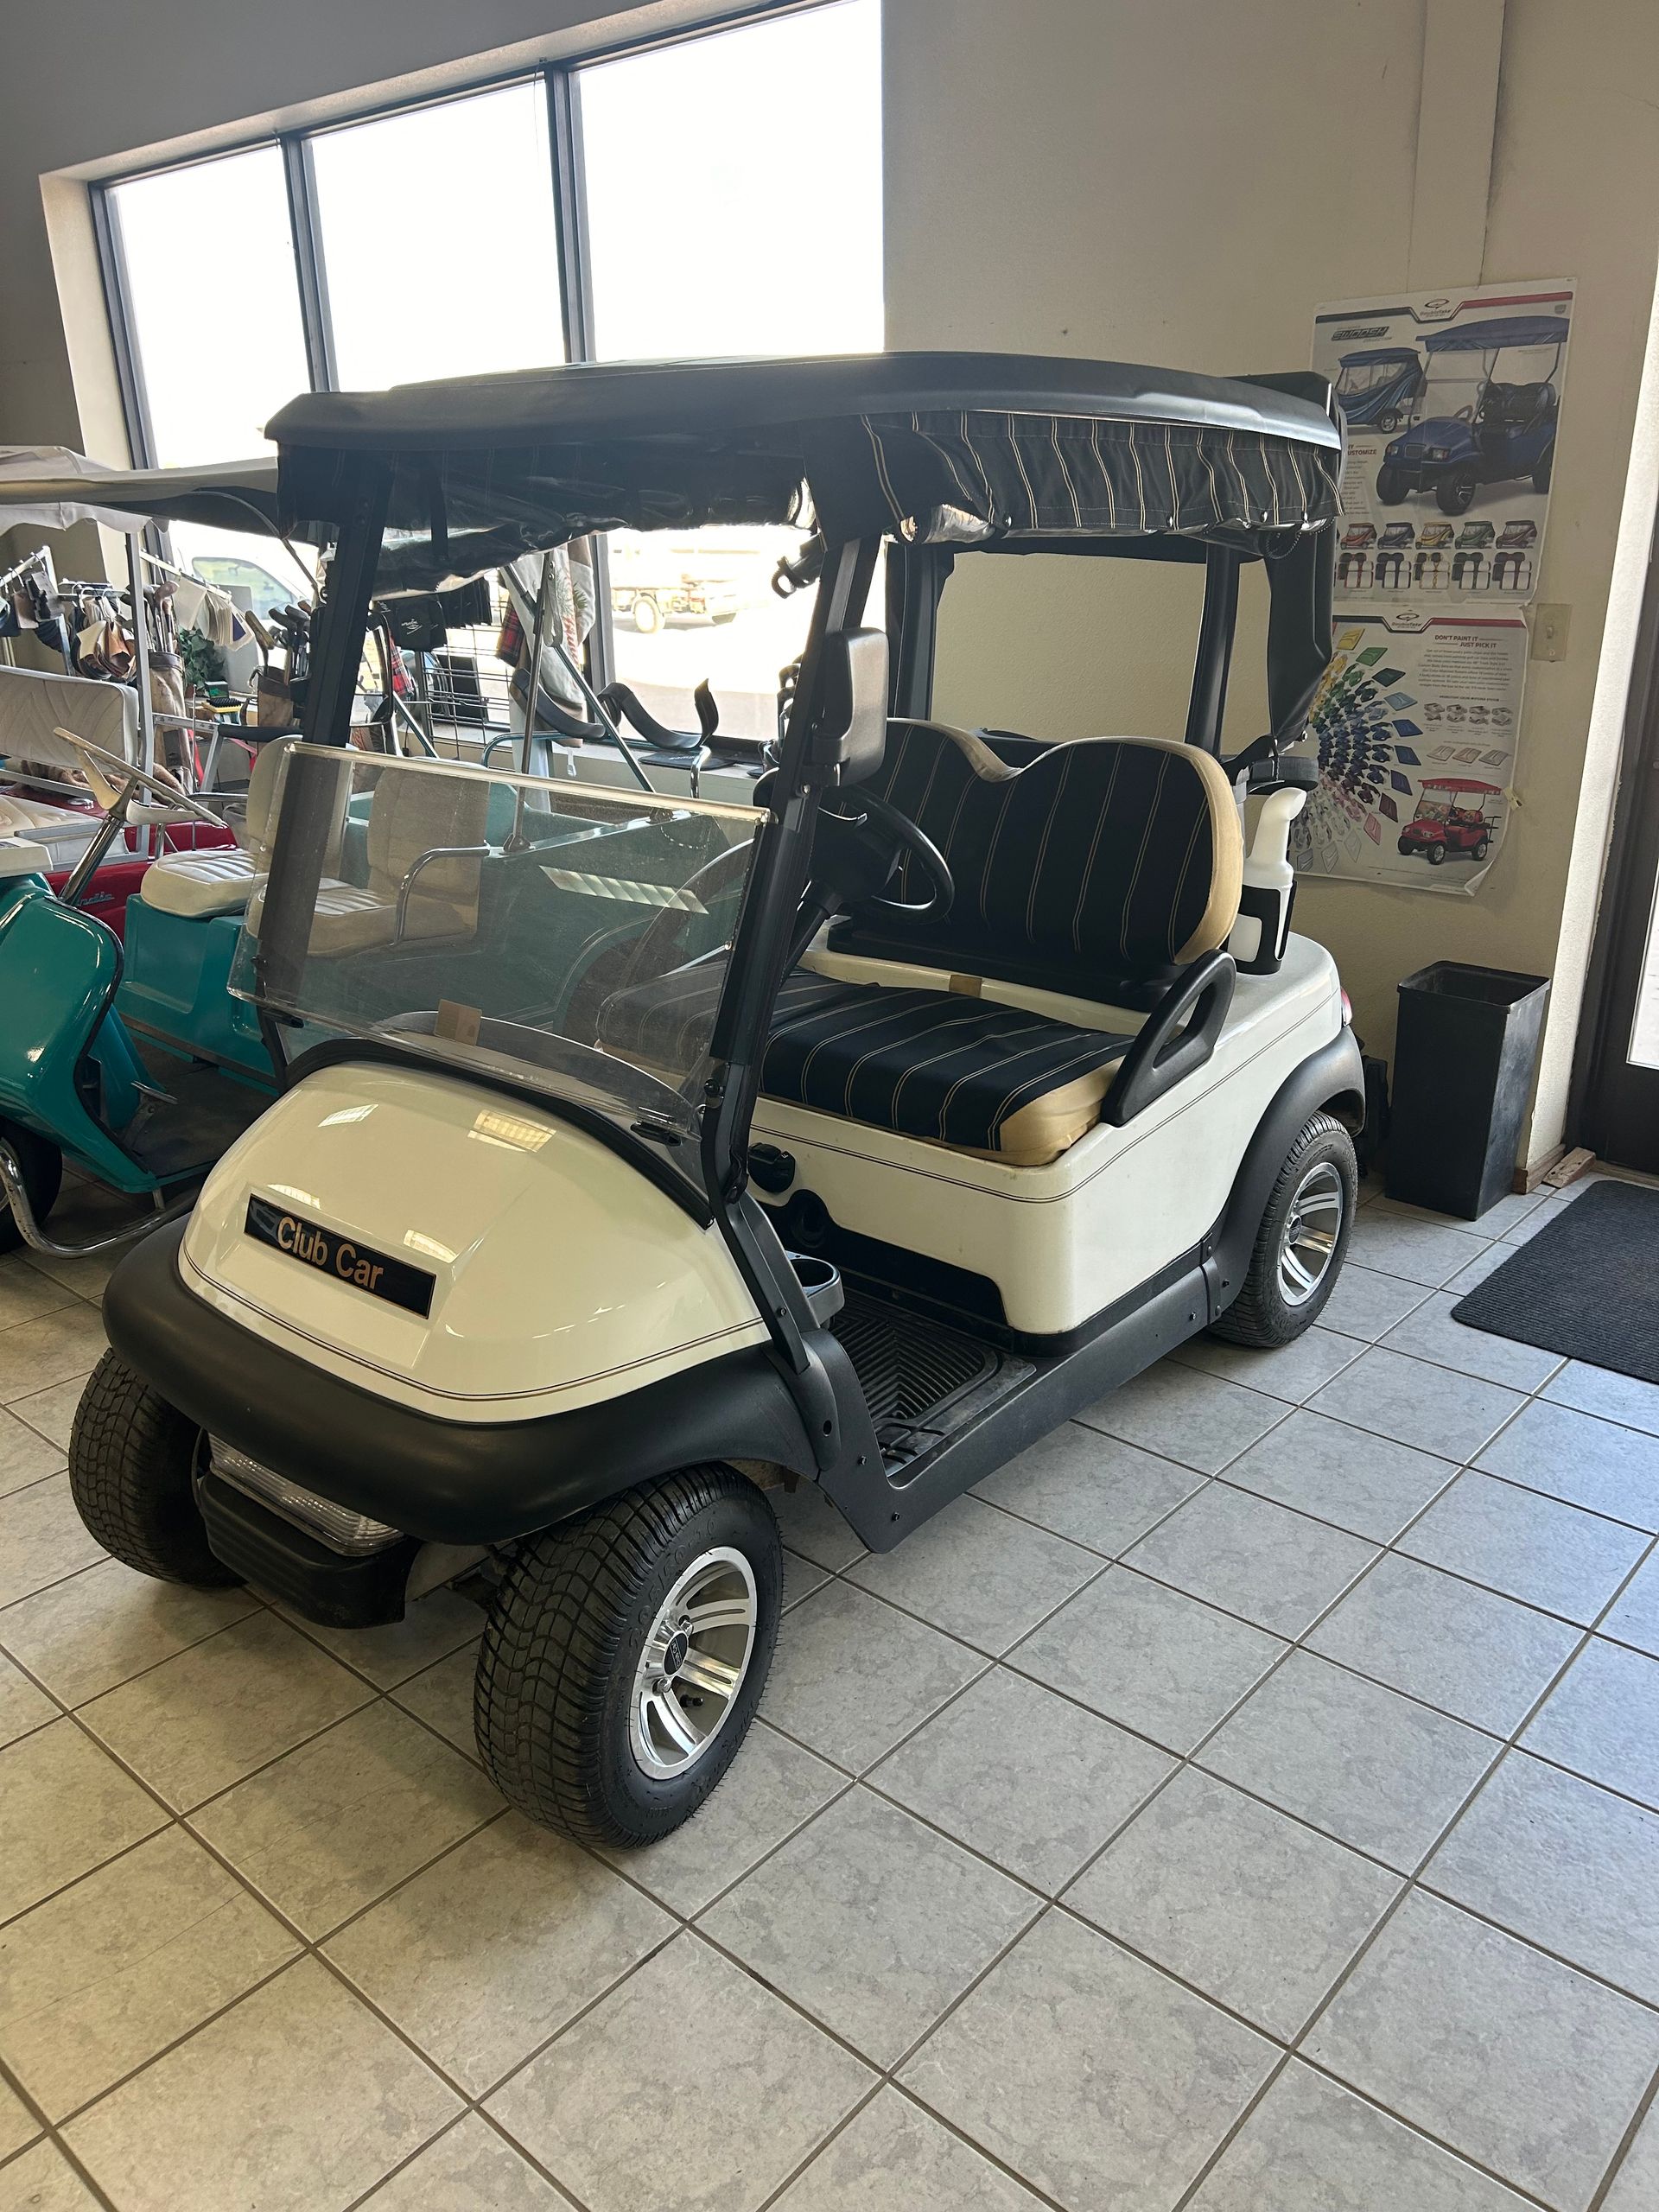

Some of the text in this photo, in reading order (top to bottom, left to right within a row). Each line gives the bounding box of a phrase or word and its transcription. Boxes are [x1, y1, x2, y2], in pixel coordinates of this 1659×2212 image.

[1332, 327, 1389, 340] SWOOSH
[277, 1217, 384, 1289] Club Car
